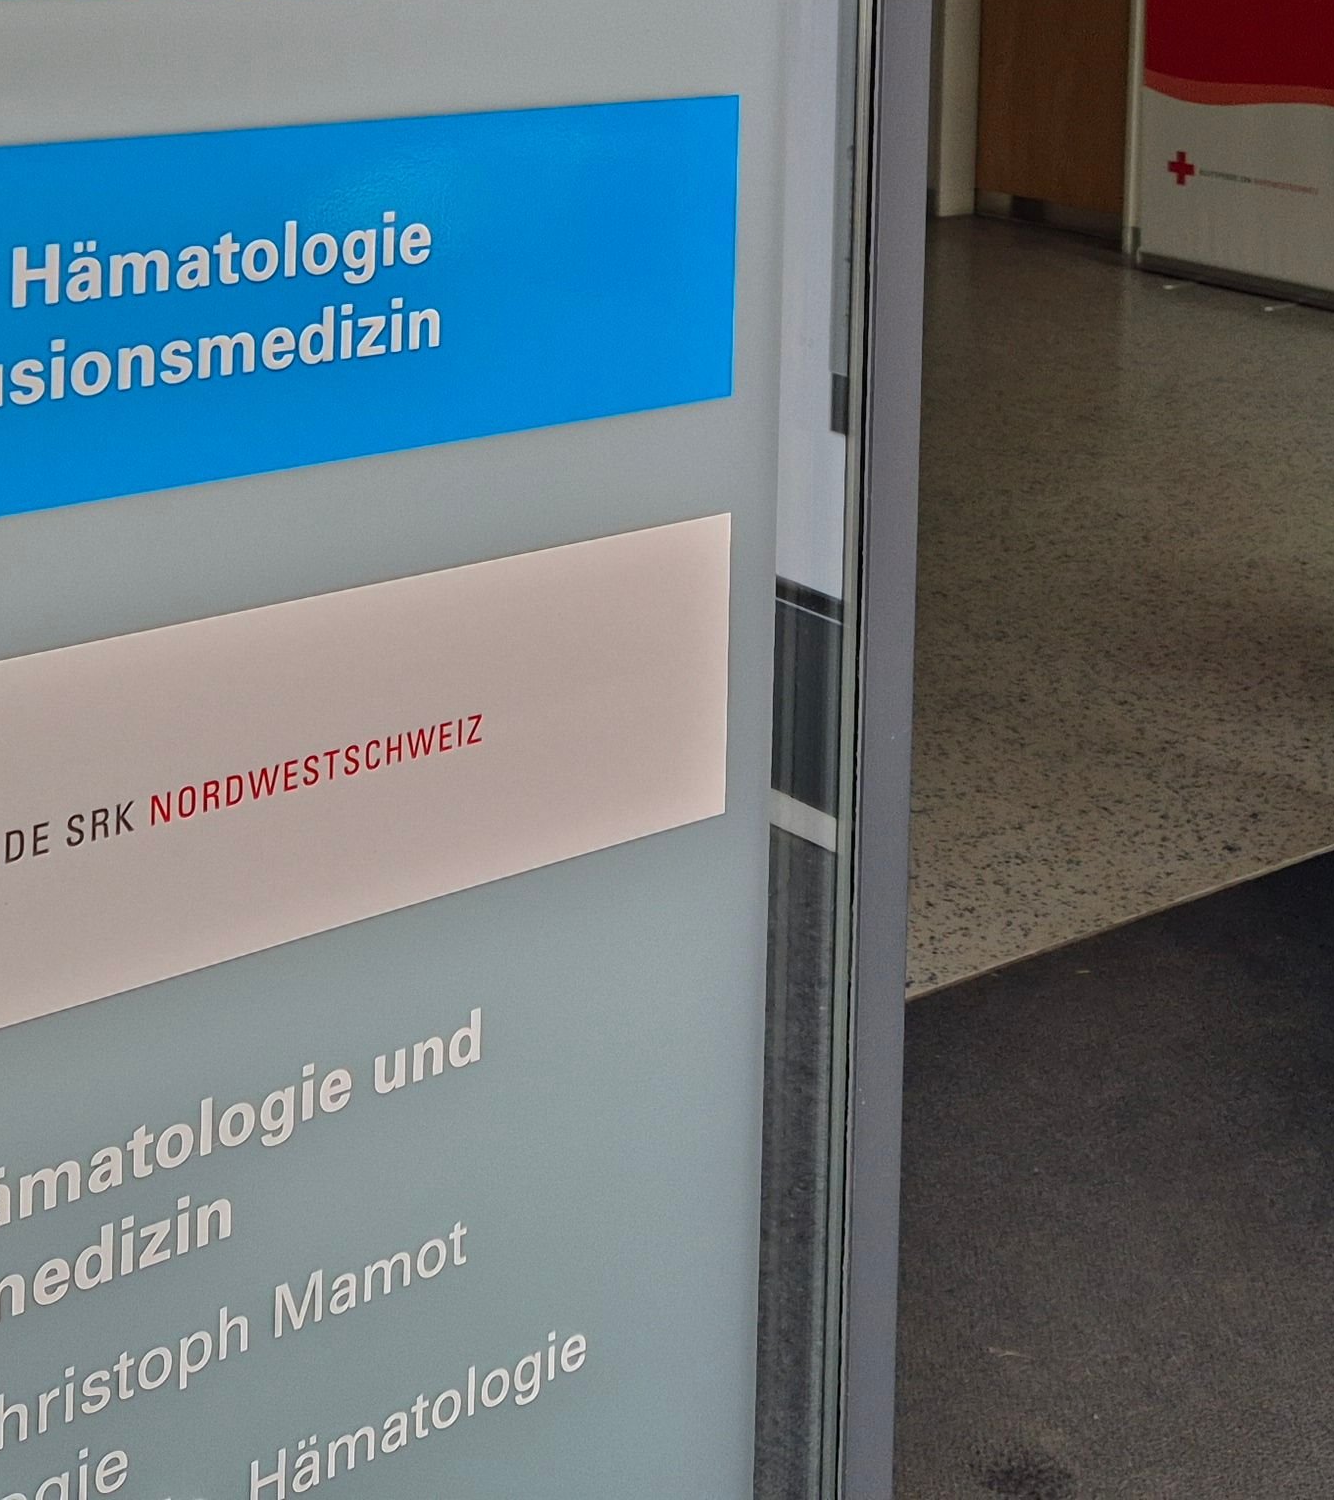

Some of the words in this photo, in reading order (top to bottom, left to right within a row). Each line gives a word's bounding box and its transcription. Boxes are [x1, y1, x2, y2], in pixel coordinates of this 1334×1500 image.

[10, 211, 433, 309] Hämatologie
[65, 800, 136, 847] SRK
[149, 713, 484, 826] NORDWESTSCHWEIZ
[373, 1008, 483, 1094] und
[273, 1220, 468, 1338] Mamot
[250, 1330, 587, 1500] Hämatologie
